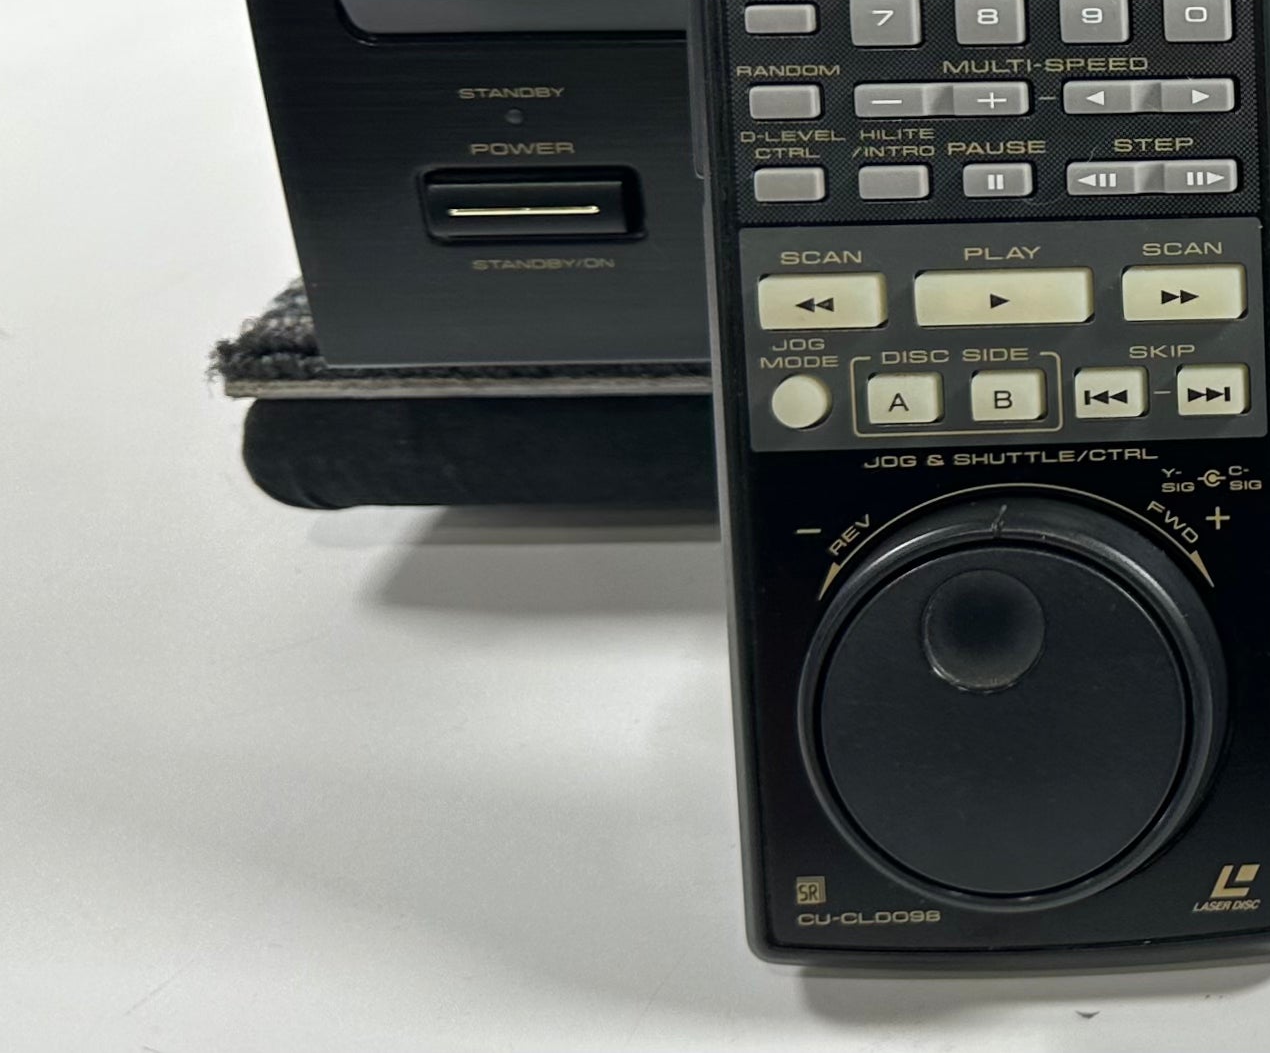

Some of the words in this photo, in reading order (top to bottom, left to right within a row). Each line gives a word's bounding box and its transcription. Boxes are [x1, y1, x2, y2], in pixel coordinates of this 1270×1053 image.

[872, 9, 894, 26] 7
[977, 8, 999, 25] 8
[1080, 8, 1104, 23] 9
[736, 65, 840, 77] RANDOM
[942, 57, 1149, 74] MULTI-SPEED
[457, 87, 565, 99] STANDBY
[740, 130, 846, 142] D-LEVEL
[860, 128, 935, 139] HILITE
[470, 143, 576, 155] POWER
[852, 146, 936, 158] /INTRO
[947, 140, 1047, 155] PAUSE
[1113, 137, 1195, 153] STEP
[755, 147, 820, 159] CTRL
[963, 247, 1042, 262] PLAY
[1141, 243, 1224, 256] SCAN
[471, 259, 616, 271] STANDBY/ON
[780, 251, 863, 266] SCAN
[772, 339, 826, 352] JOG
[1129, 345, 1196, 359] SKIP
[759, 356, 840, 370] MODE
[880, 350, 950, 365] DISC
[961, 349, 1030, 363] SIDE
[888, 394, 910, 412] A
[994, 391, 1013, 409] B
[863, 455, 919, 468] JOG
[927, 454, 943, 466] &
[952, 449, 1160, 465] SHUTTLE/CTRL
[1161, 482, 1195, 493] SIG
[1229, 480, 1263, 491] SIG
[1146, 500, 1199, 545] FWD
[828, 513, 873, 557] REV
[1192, 900, 1232, 912] LASER
[1231, 898, 1261, 910] DISC
